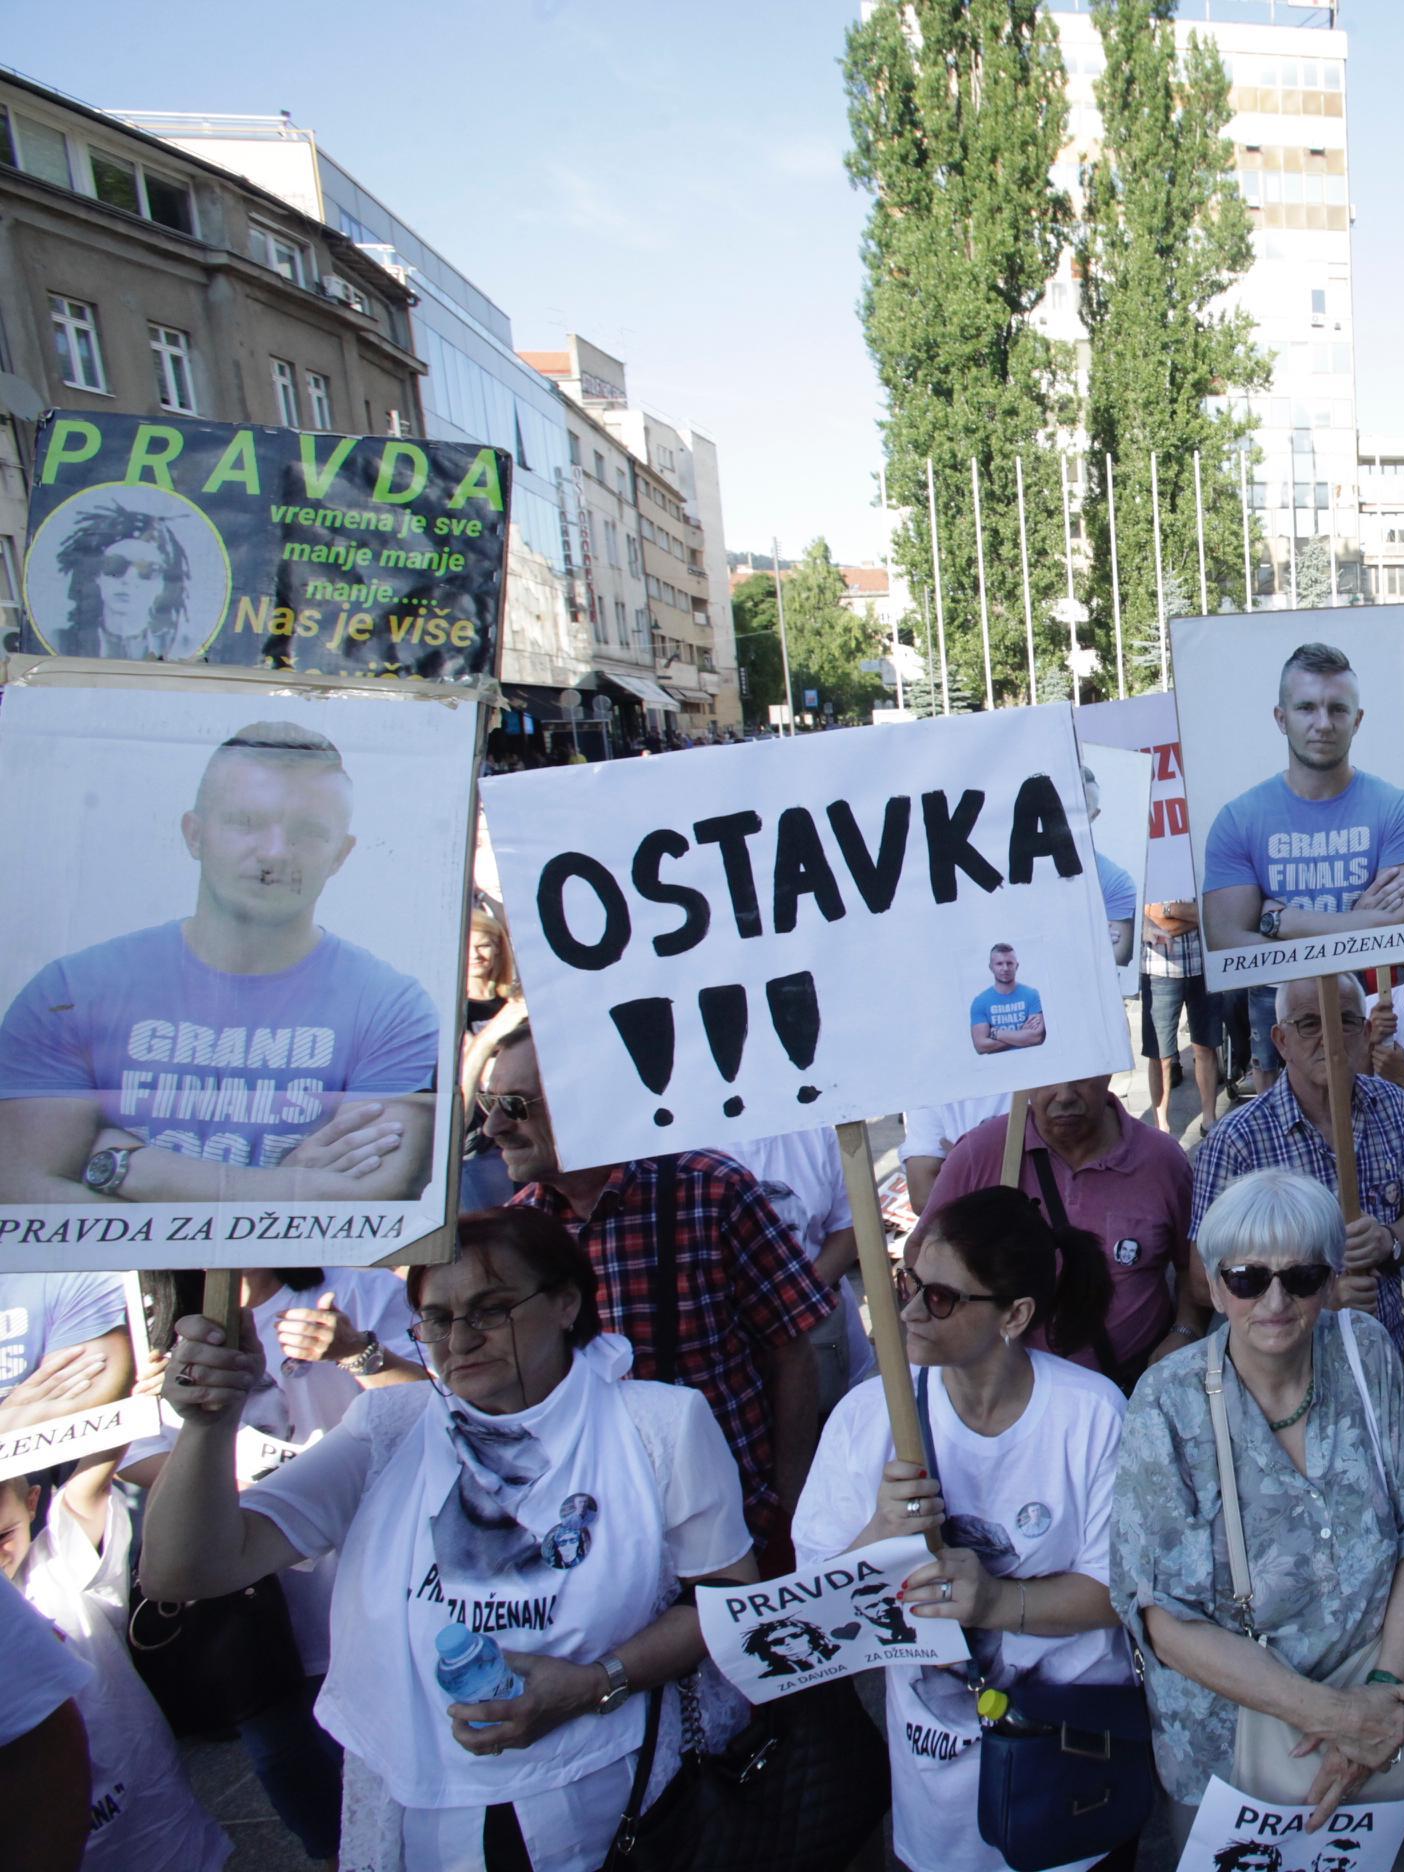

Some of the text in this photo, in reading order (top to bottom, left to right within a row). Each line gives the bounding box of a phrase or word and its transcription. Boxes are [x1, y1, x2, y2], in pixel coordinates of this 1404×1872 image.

[41, 419, 505, 512] PRAVDA
[270, 504, 483, 538] vremena je sve
[283, 539, 465, 577] manje manje
[235, 595, 475, 649] Nas je više
[1267, 826, 1371, 861] GRAND
[536, 773, 1084, 971] OSTAVKA
[1267, 856, 1369, 892] FINALS
[1222, 950, 1299, 973] PRAVDA
[1303, 944, 1327, 961] ZA
[990, 1001, 1026, 1014] GRAND
[991, 1011, 1027, 1025] FINALS
[128, 1019, 336, 1069] GRAND
[119, 1069, 324, 1124] FINALS
[166, 1216, 215, 1241] ZA
[225, 1211, 405, 1240] DŽENANA
[725, 1560, 885, 1623] PRAVDA
[864, 1646, 940, 1663] ZA DŽENANA
[777, 1664, 849, 1692] ZA DAVIDA
[905, 1721, 959, 1761] PRAVDA
[1234, 1805, 1375, 1836] PRADA
